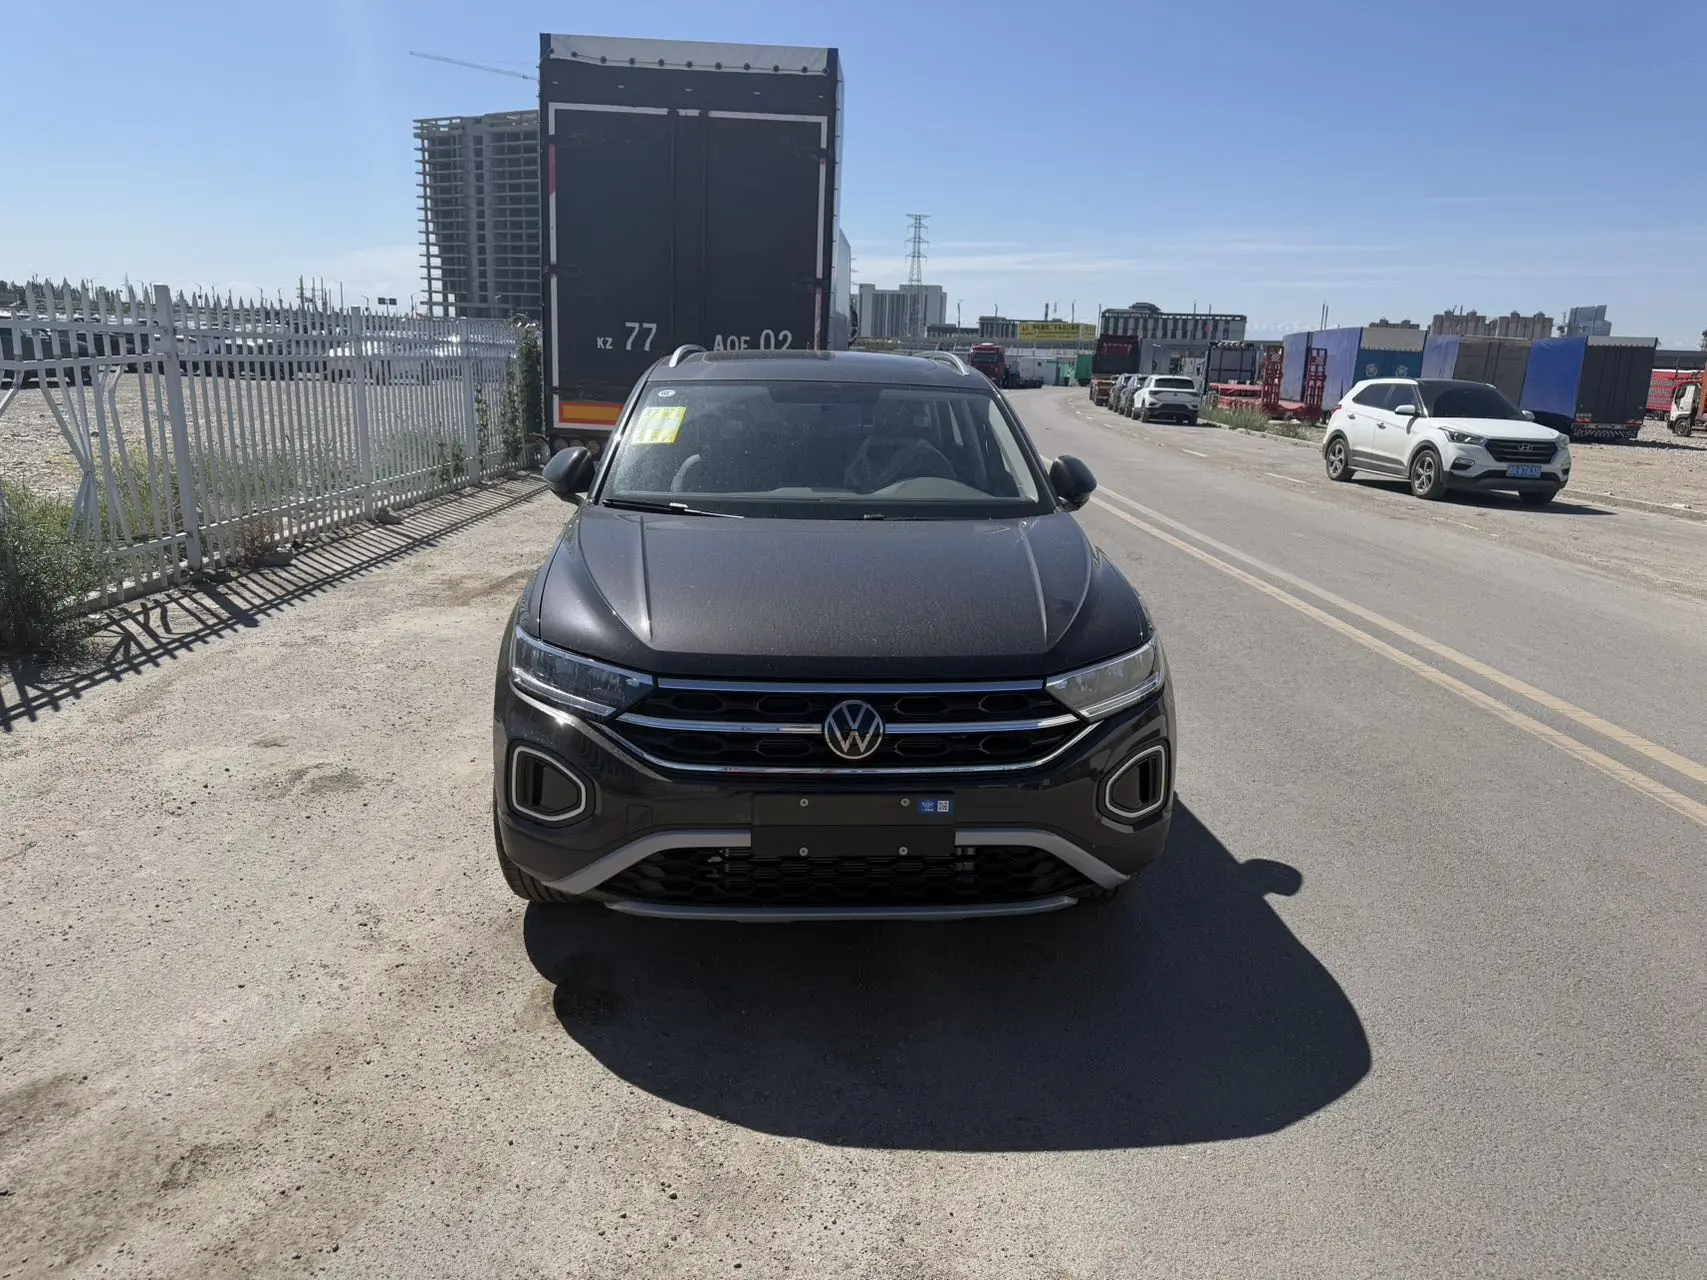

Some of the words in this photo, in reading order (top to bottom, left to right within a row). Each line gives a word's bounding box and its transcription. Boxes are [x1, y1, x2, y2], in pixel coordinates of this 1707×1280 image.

[596, 336, 613, 350] KZ
[624, 321, 658, 351] 77
[759, 328, 793, 351] 02
